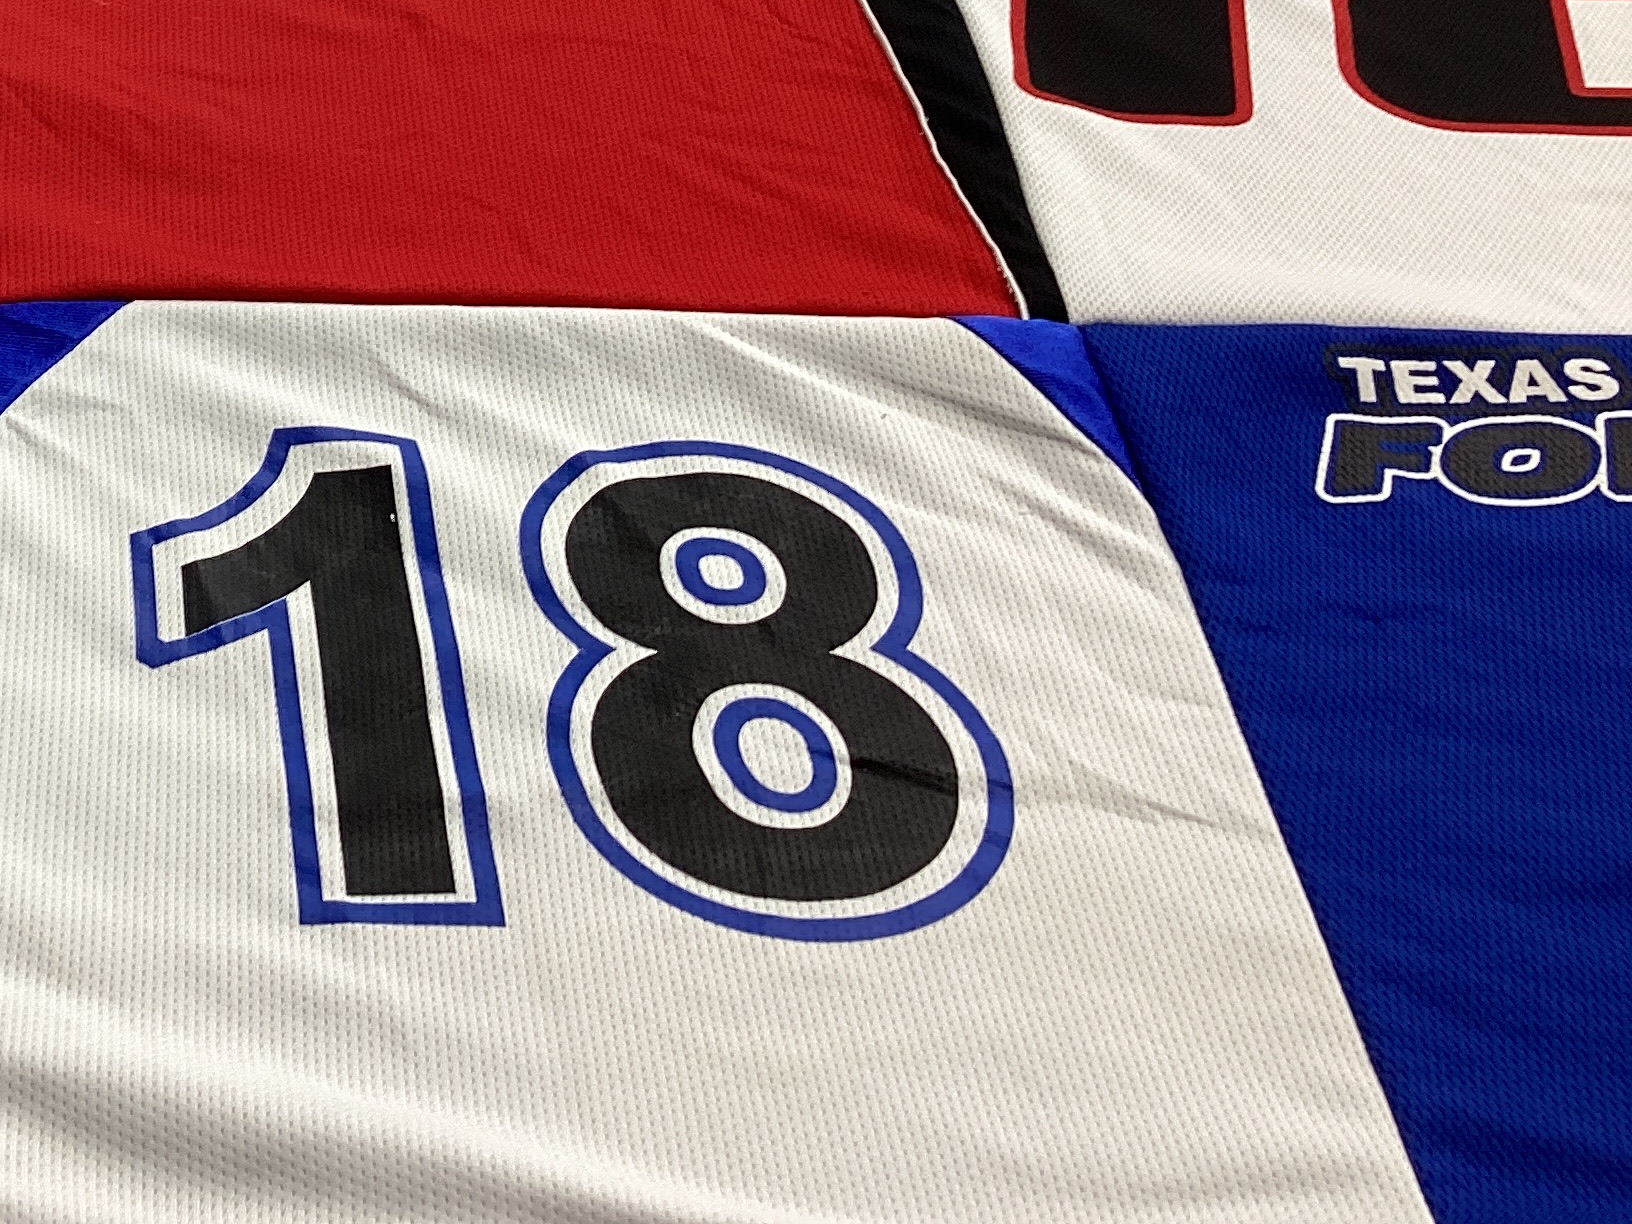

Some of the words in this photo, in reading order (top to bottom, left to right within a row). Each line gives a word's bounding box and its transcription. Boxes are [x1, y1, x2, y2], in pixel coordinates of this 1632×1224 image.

[1338, 356, 1620, 405] TEXAS
[1316, 410, 1632, 507] FO
[131, 427, 1015, 943] 18
